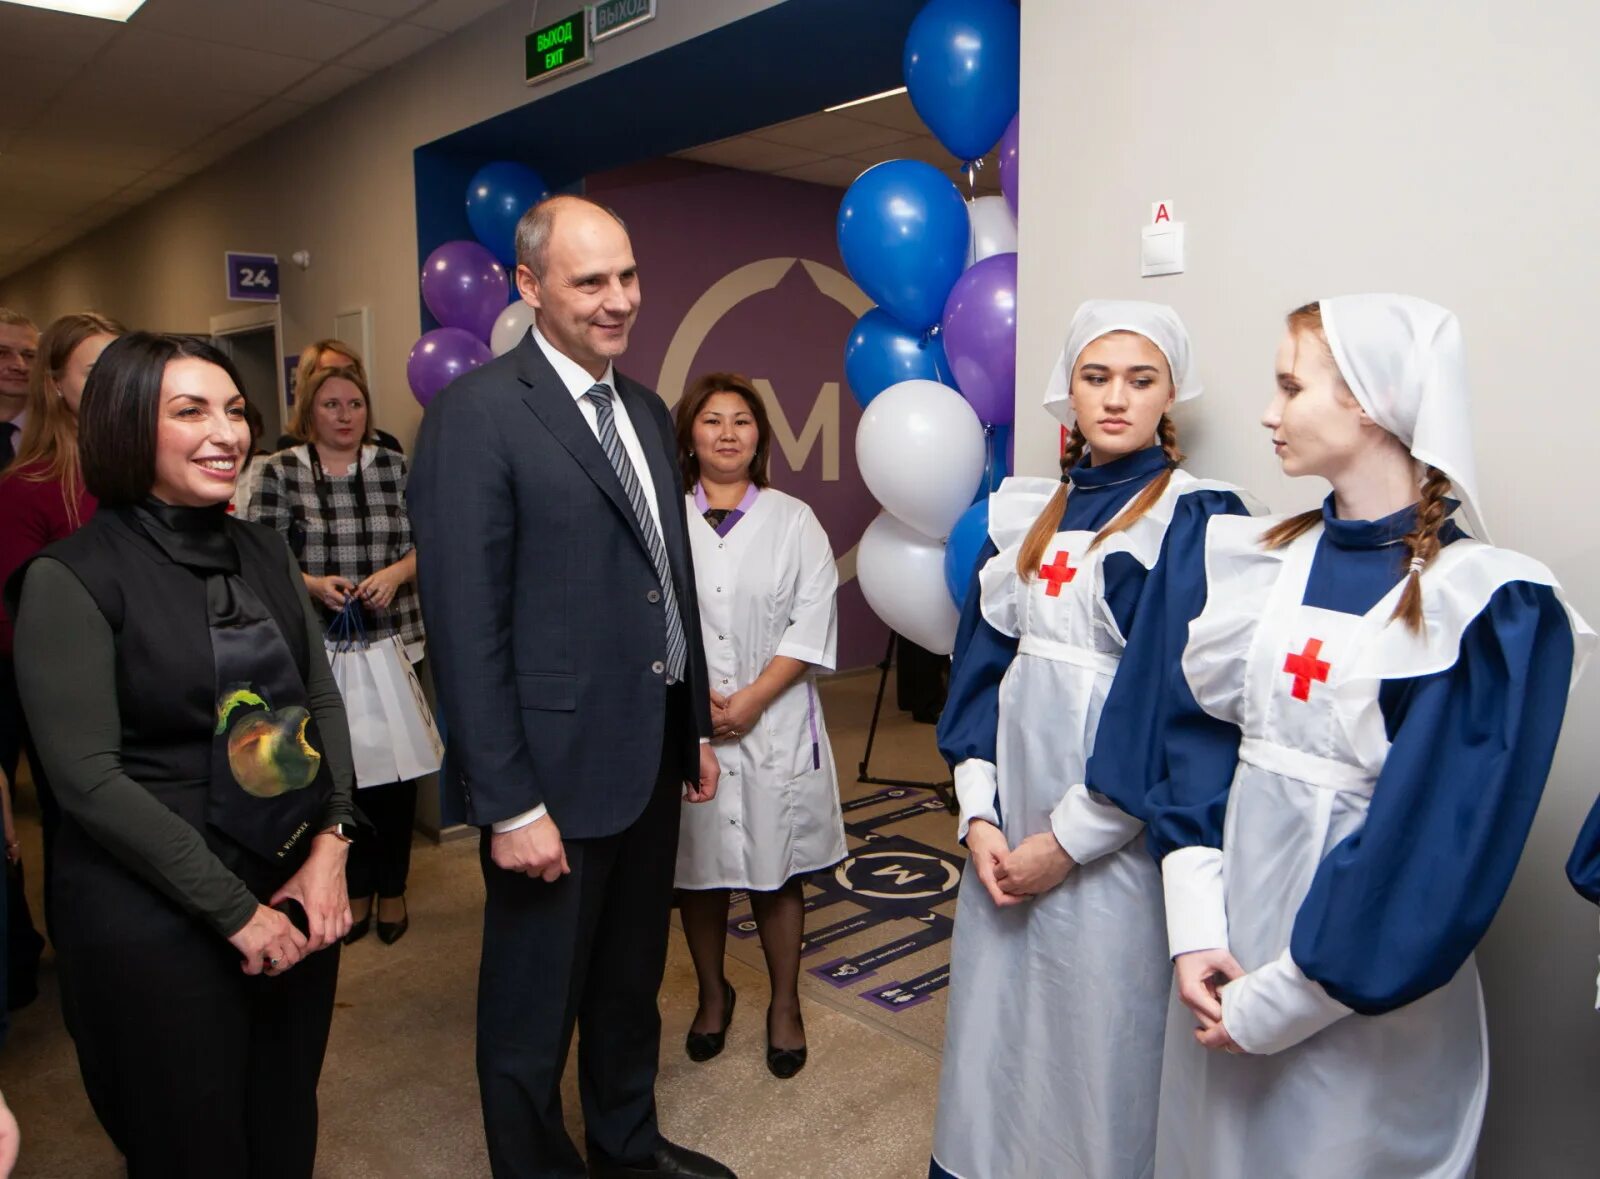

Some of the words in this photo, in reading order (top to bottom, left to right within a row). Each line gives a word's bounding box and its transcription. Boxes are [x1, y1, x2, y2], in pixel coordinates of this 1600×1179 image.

[600, 0, 646, 28] ВЫХОД
[538, 22, 572, 52] ВЫХОД
[545, 48, 564, 69] EXIT
[240, 268, 271, 288] 24
[752, 379, 840, 481] M
